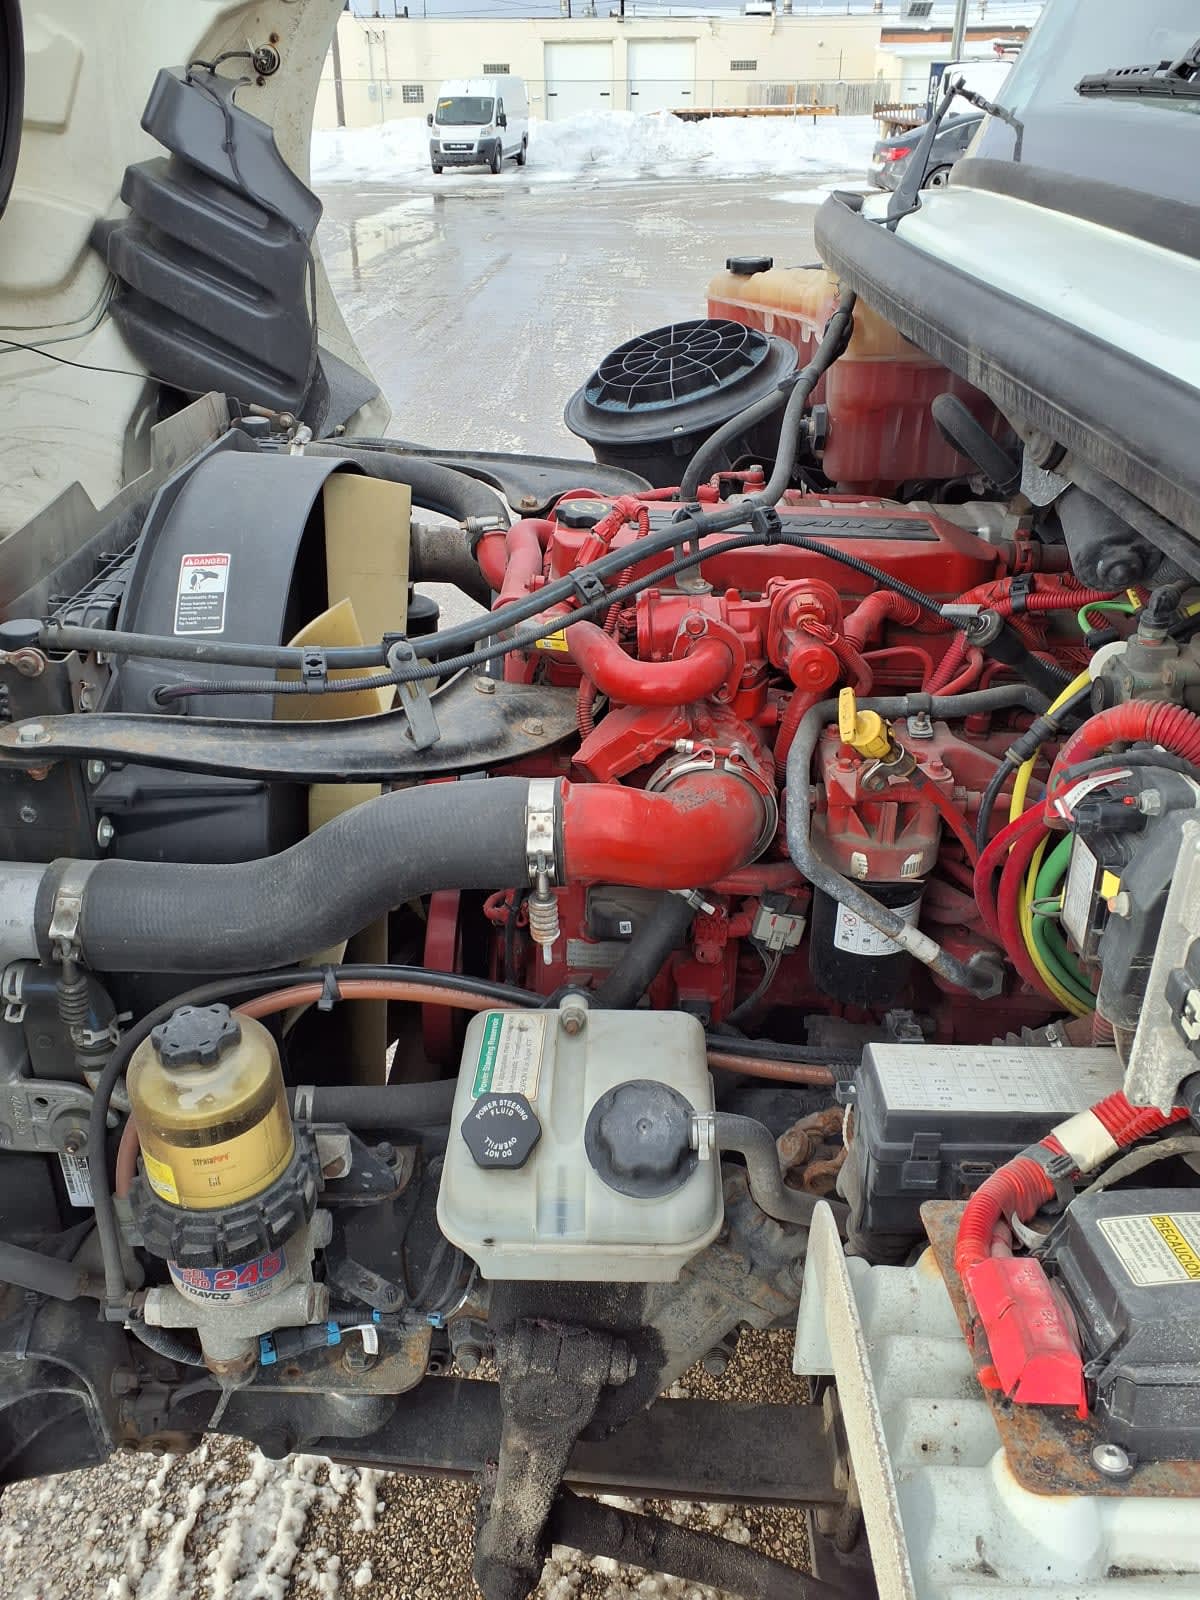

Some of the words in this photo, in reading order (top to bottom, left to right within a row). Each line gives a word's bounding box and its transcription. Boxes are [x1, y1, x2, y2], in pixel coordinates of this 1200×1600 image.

[193, 557, 227, 566] DANGER
[475, 1100, 498, 1120] POWER
[499, 1099, 528, 1121] STEERING
[490, 1107, 514, 1116] FLUID
[484, 1136, 517, 1150] OVERFILL
[484, 1149, 500, 1158] NOT
[501, 1149, 512, 1158] DO
[1151, 1216, 1200, 1278] PRECAUCION
[214, 1250, 281, 1290] 245
[189, 1288, 232, 1300] DAVCO
